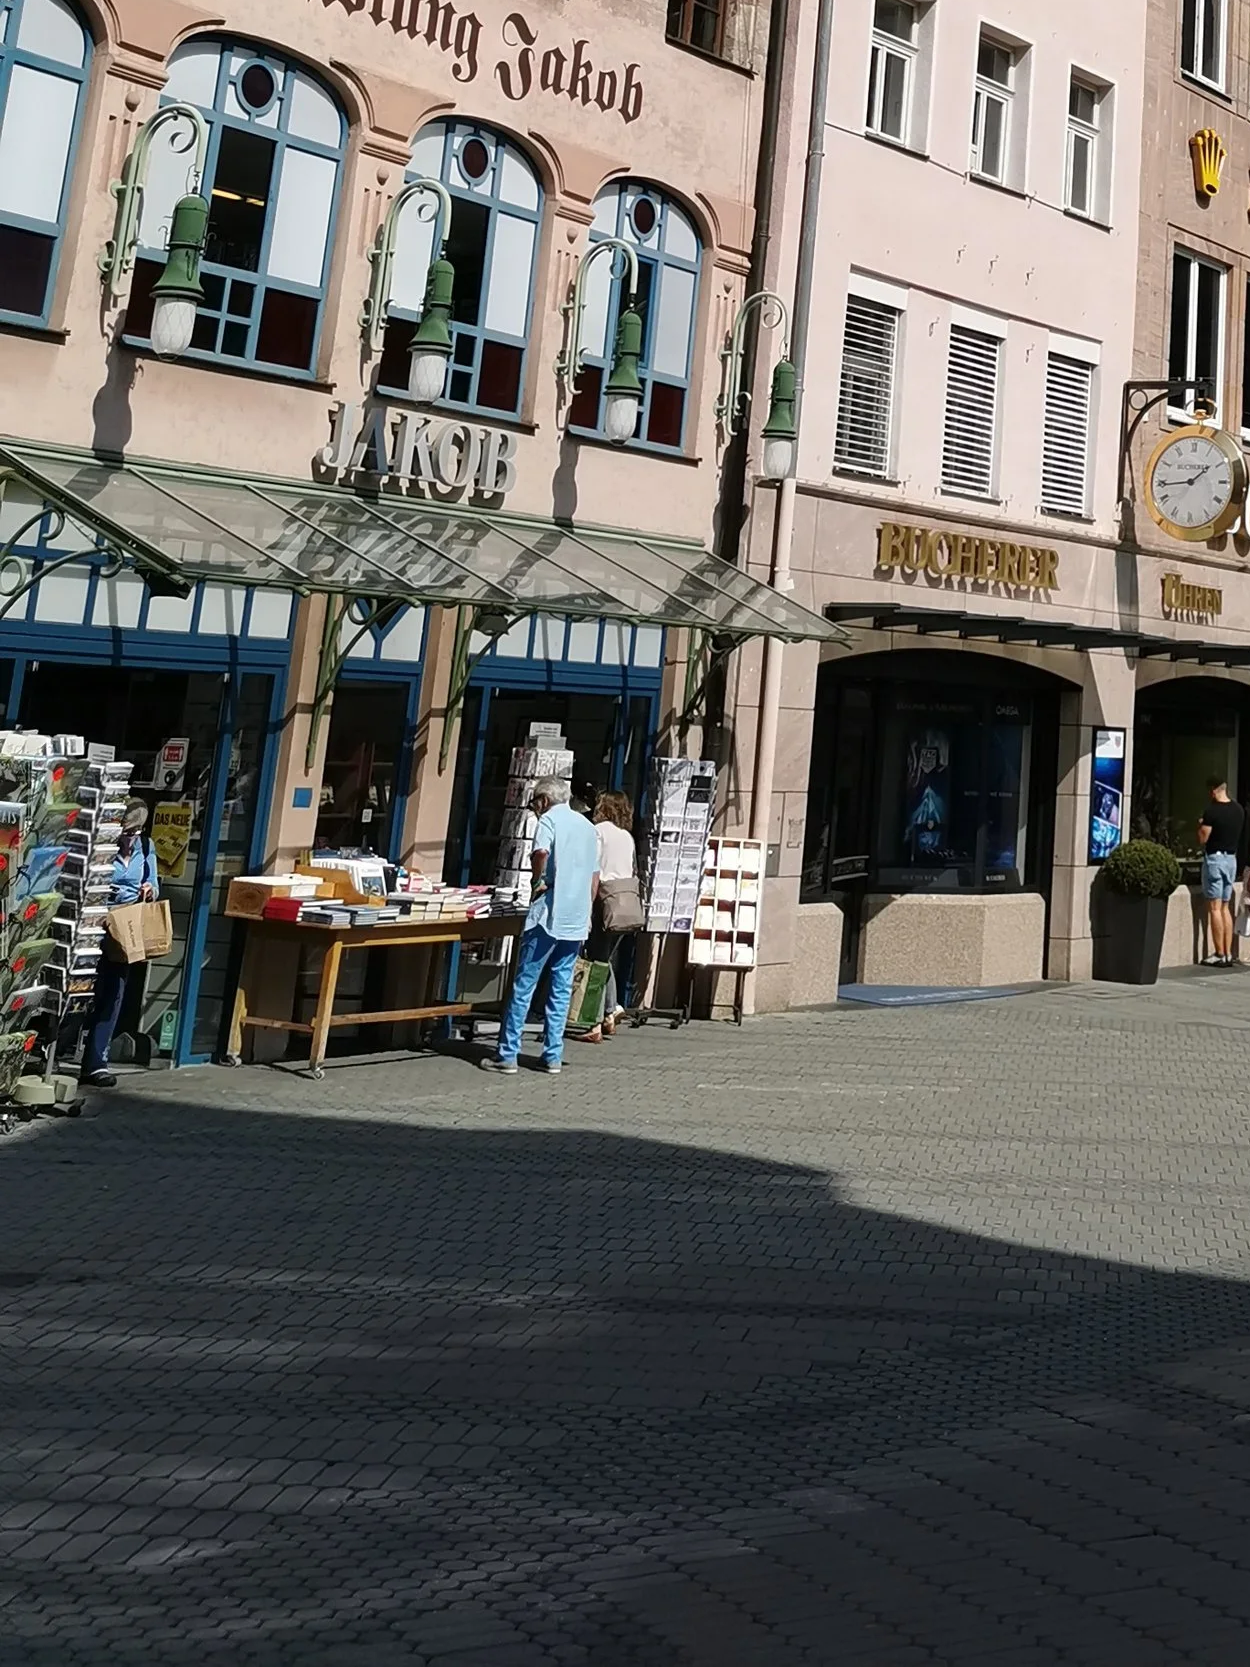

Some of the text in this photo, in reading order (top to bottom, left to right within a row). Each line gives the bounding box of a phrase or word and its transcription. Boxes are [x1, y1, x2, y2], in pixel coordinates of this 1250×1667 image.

[494, 12, 643, 125] Jakob
[318, 400, 518, 493] JAKOB
[879, 521, 1061, 591] BUCHERER
[155, 812, 191, 826] DAS NEUE
